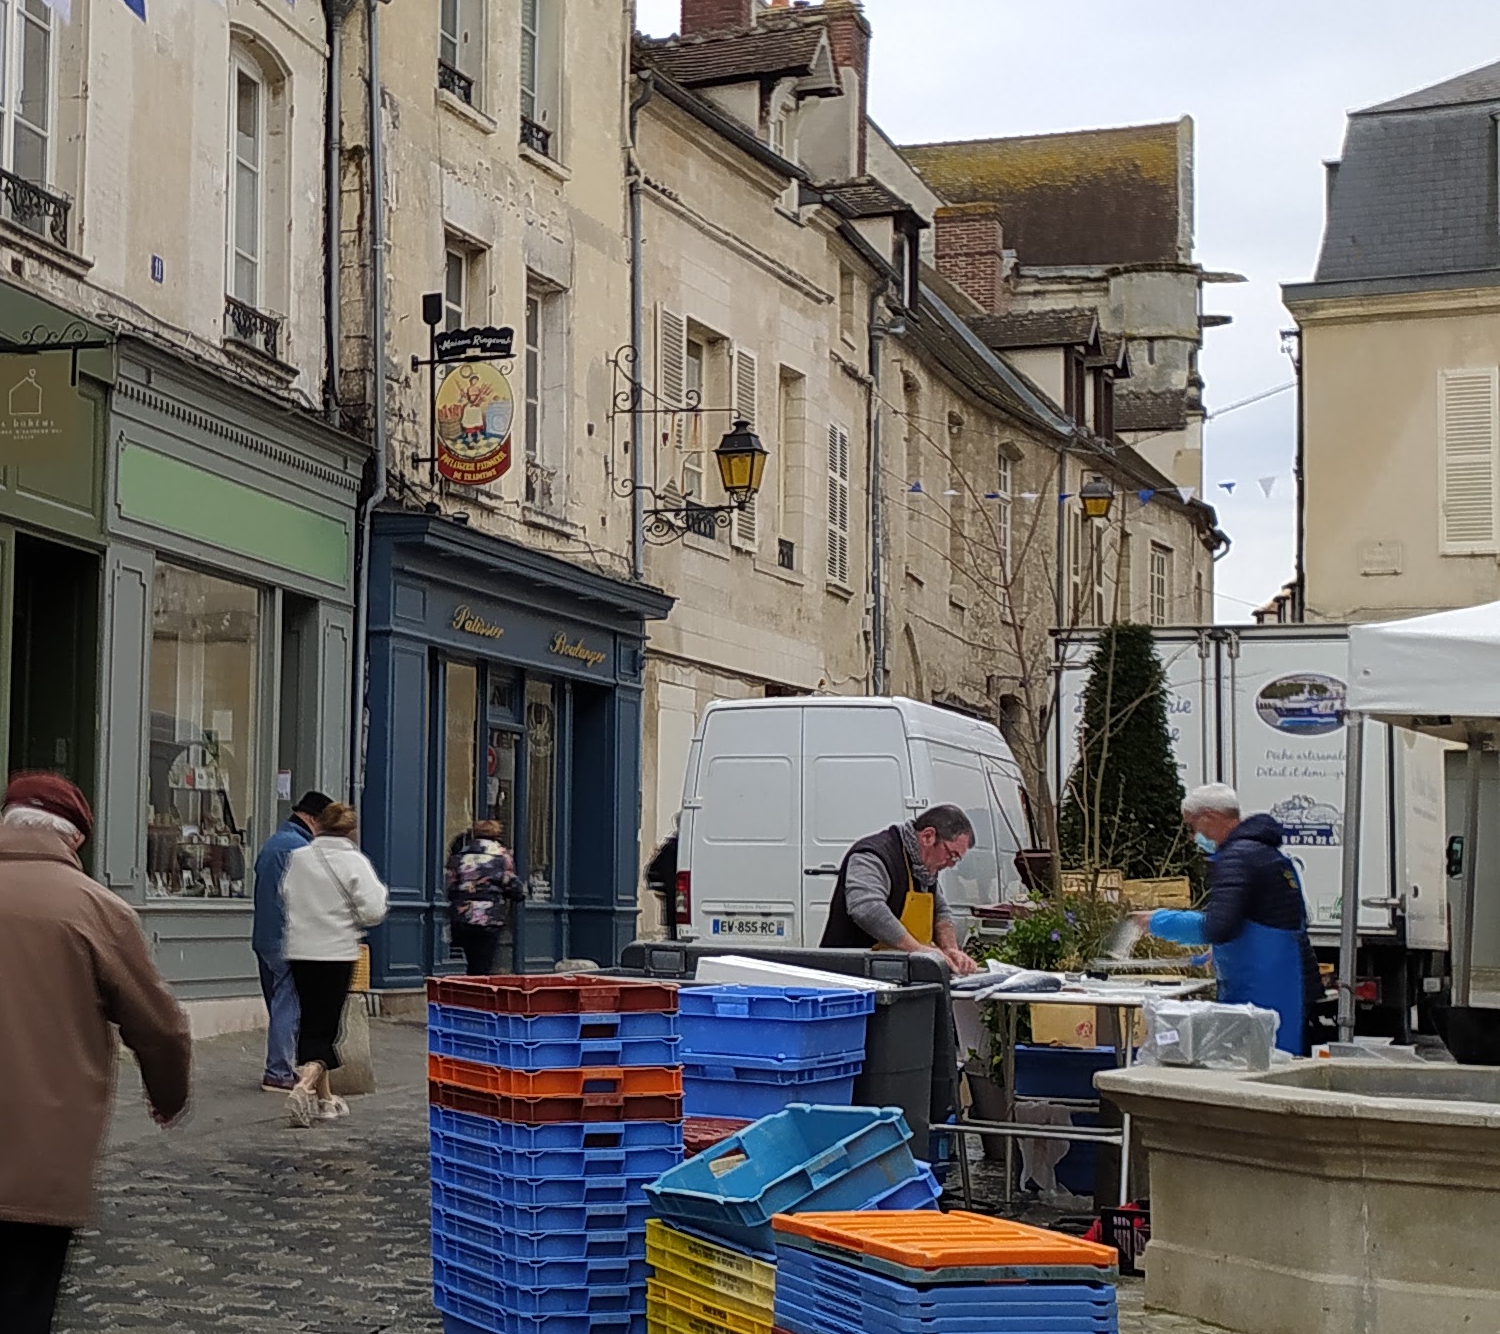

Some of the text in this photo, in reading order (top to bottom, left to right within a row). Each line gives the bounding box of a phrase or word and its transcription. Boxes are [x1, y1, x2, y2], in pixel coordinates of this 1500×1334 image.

[452, 604, 505, 639] Pâtissier
[550, 630, 606, 668] Boulanger
[720, 920, 775, 934] EV-855-RC
